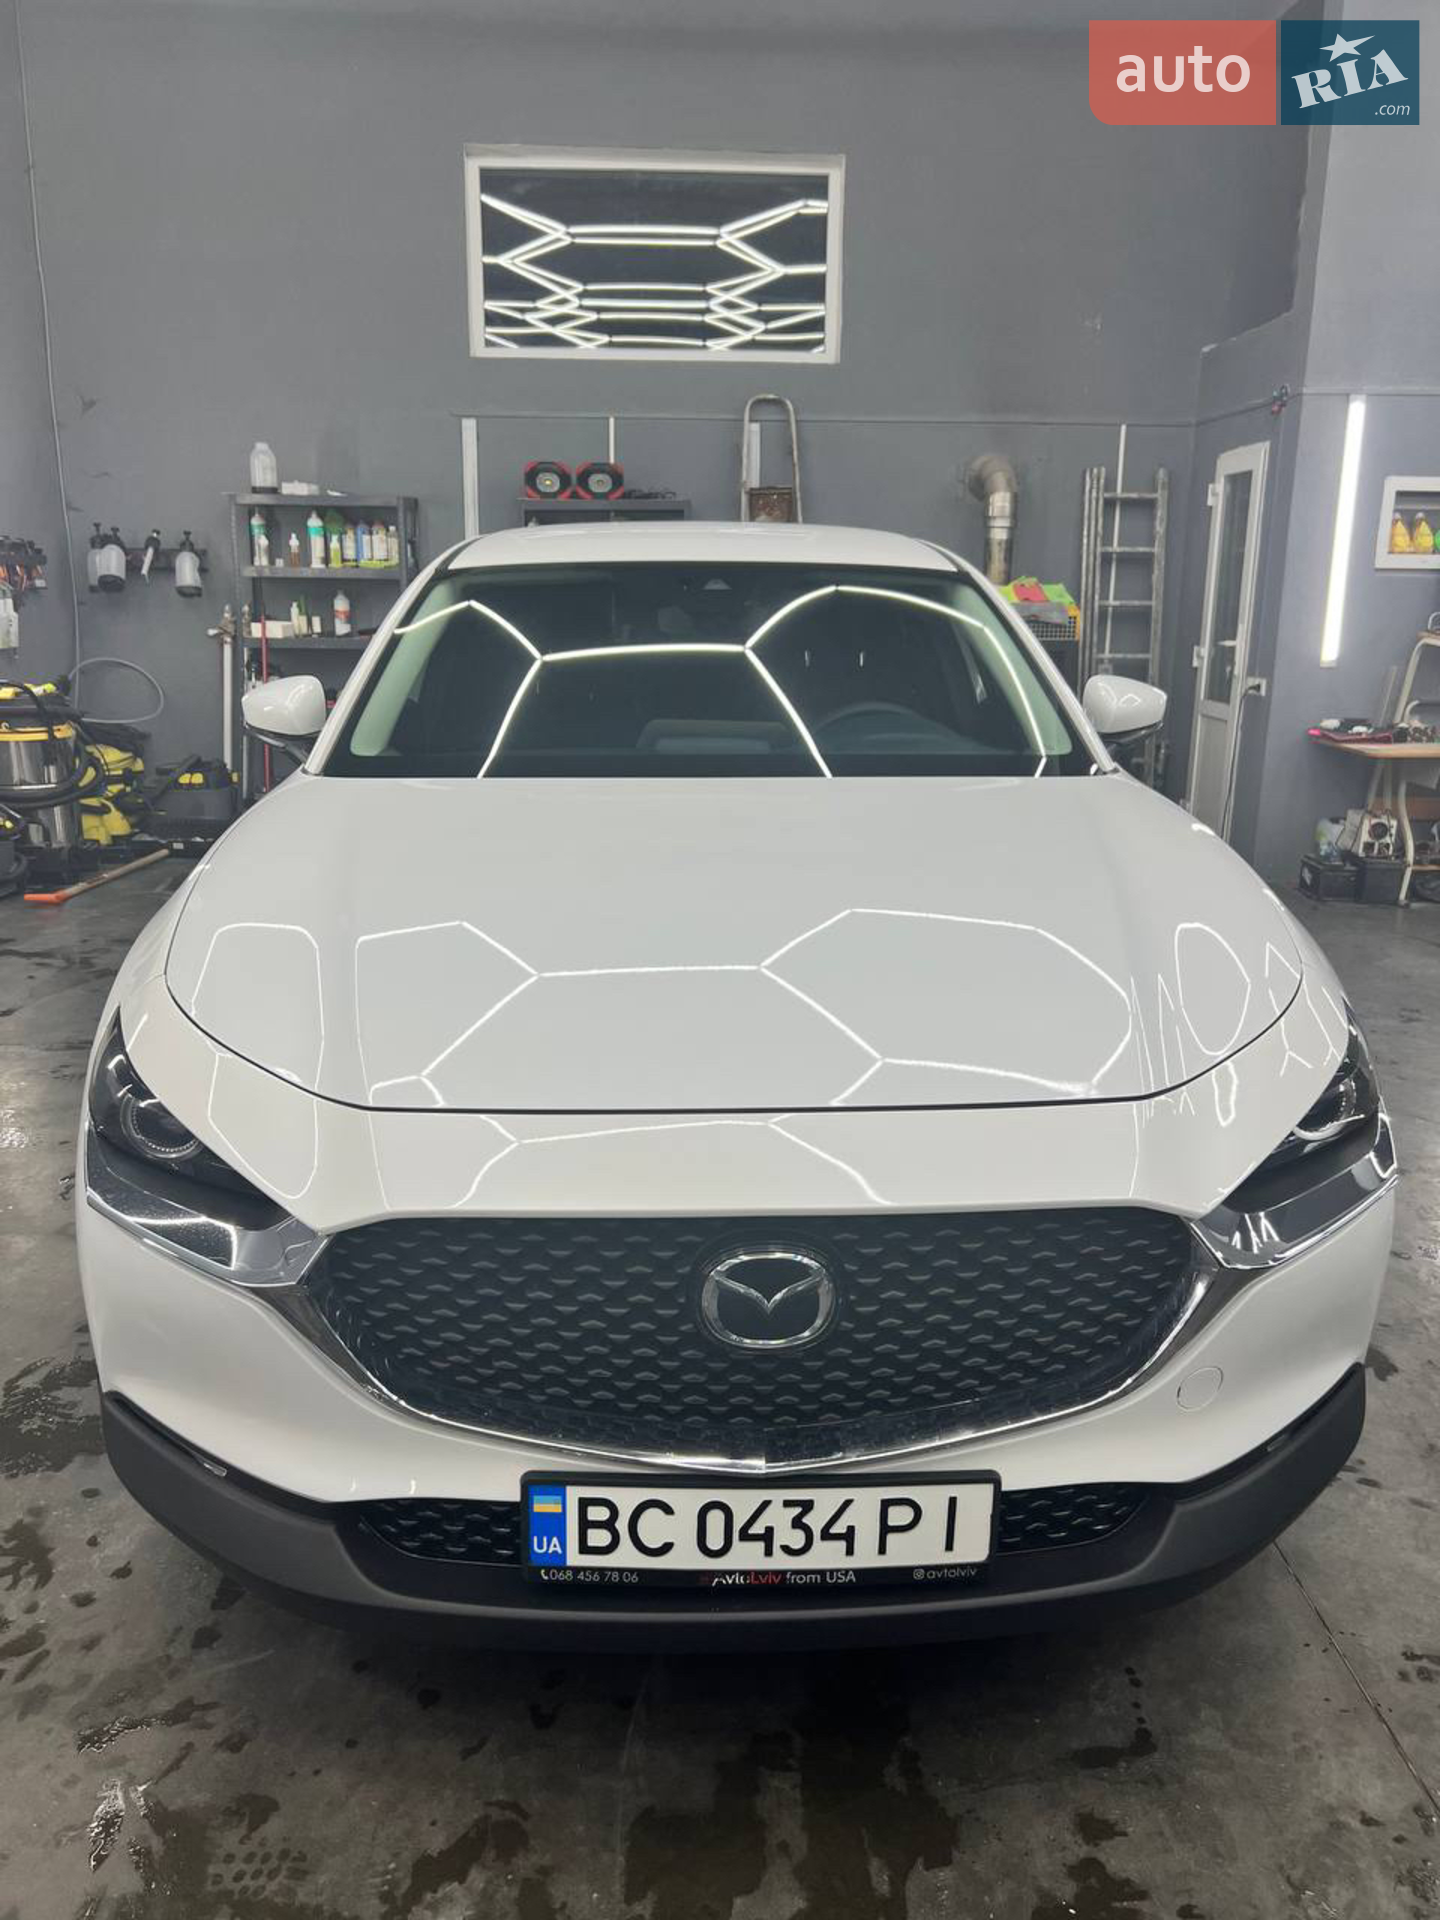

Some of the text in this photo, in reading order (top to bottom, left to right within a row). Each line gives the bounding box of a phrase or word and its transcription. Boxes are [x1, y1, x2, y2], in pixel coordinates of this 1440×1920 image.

[577, 1496, 675, 1557] BC
[696, 1498, 856, 1559] 0434
[533, 1535, 563, 1554] UA
[549, 1568, 639, 1583] 068 456 78 06
[786, 1571, 821, 1584] from
[826, 1570, 857, 1584] USA
